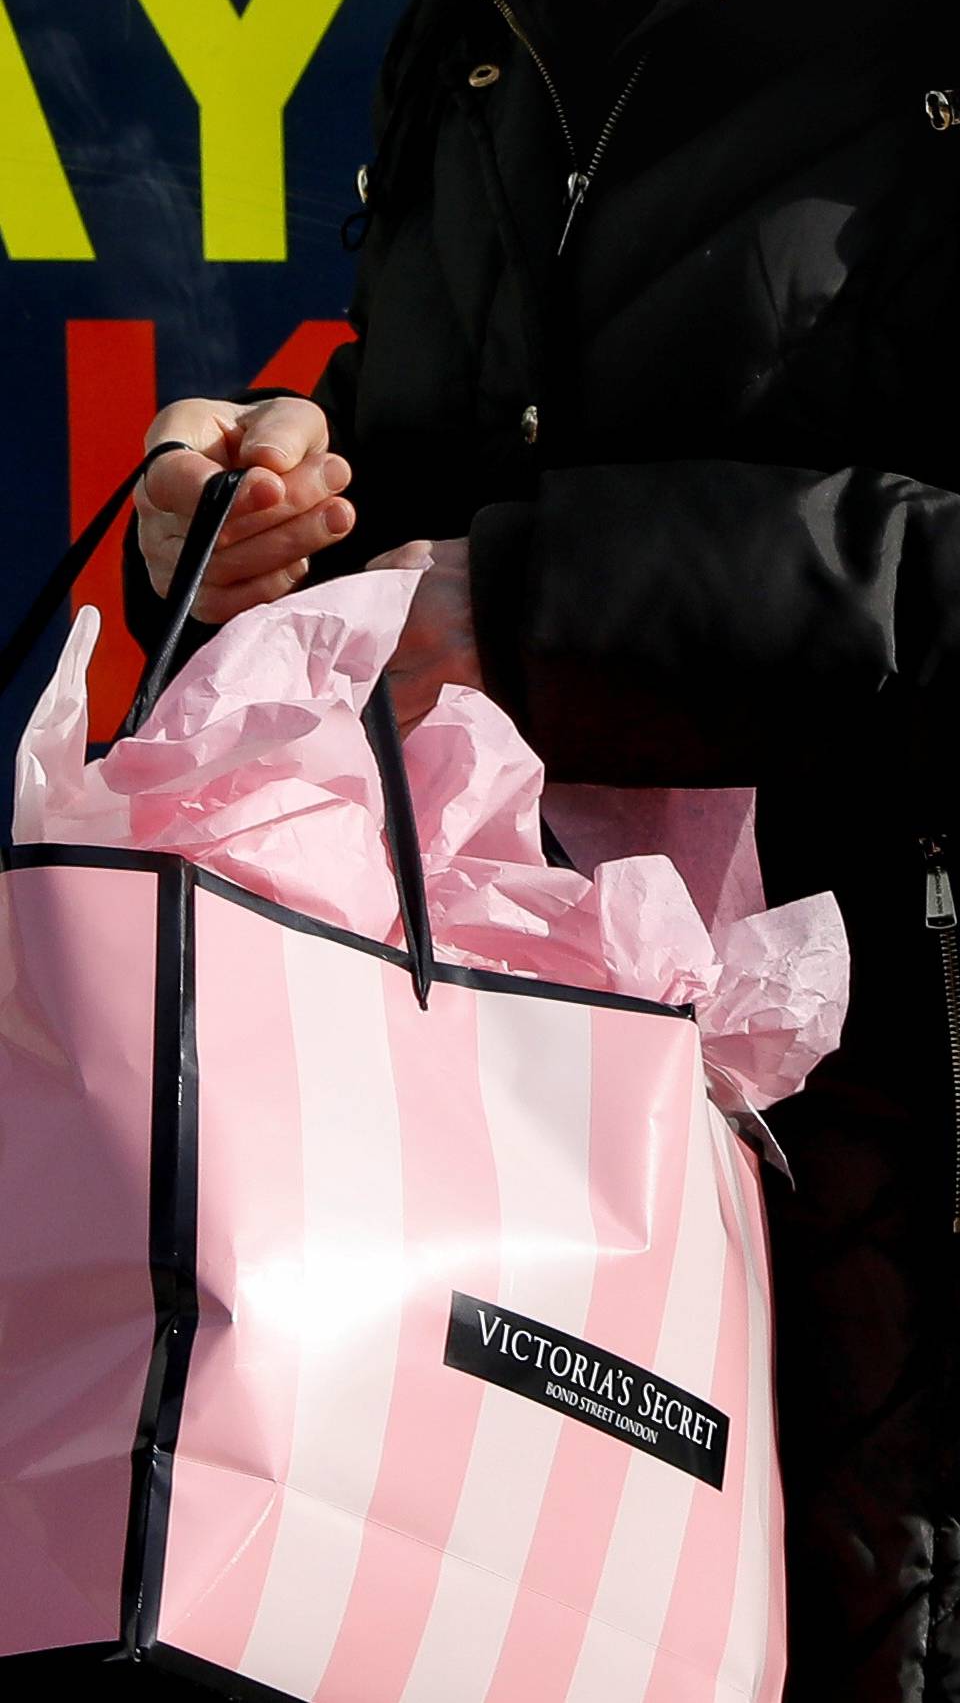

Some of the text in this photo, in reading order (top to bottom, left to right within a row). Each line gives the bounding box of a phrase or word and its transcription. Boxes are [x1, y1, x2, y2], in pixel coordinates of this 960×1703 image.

[477, 1309, 718, 1450] VICTORIA'S SECRET
[545, 1381, 659, 1445] BOND STREET LONDON
